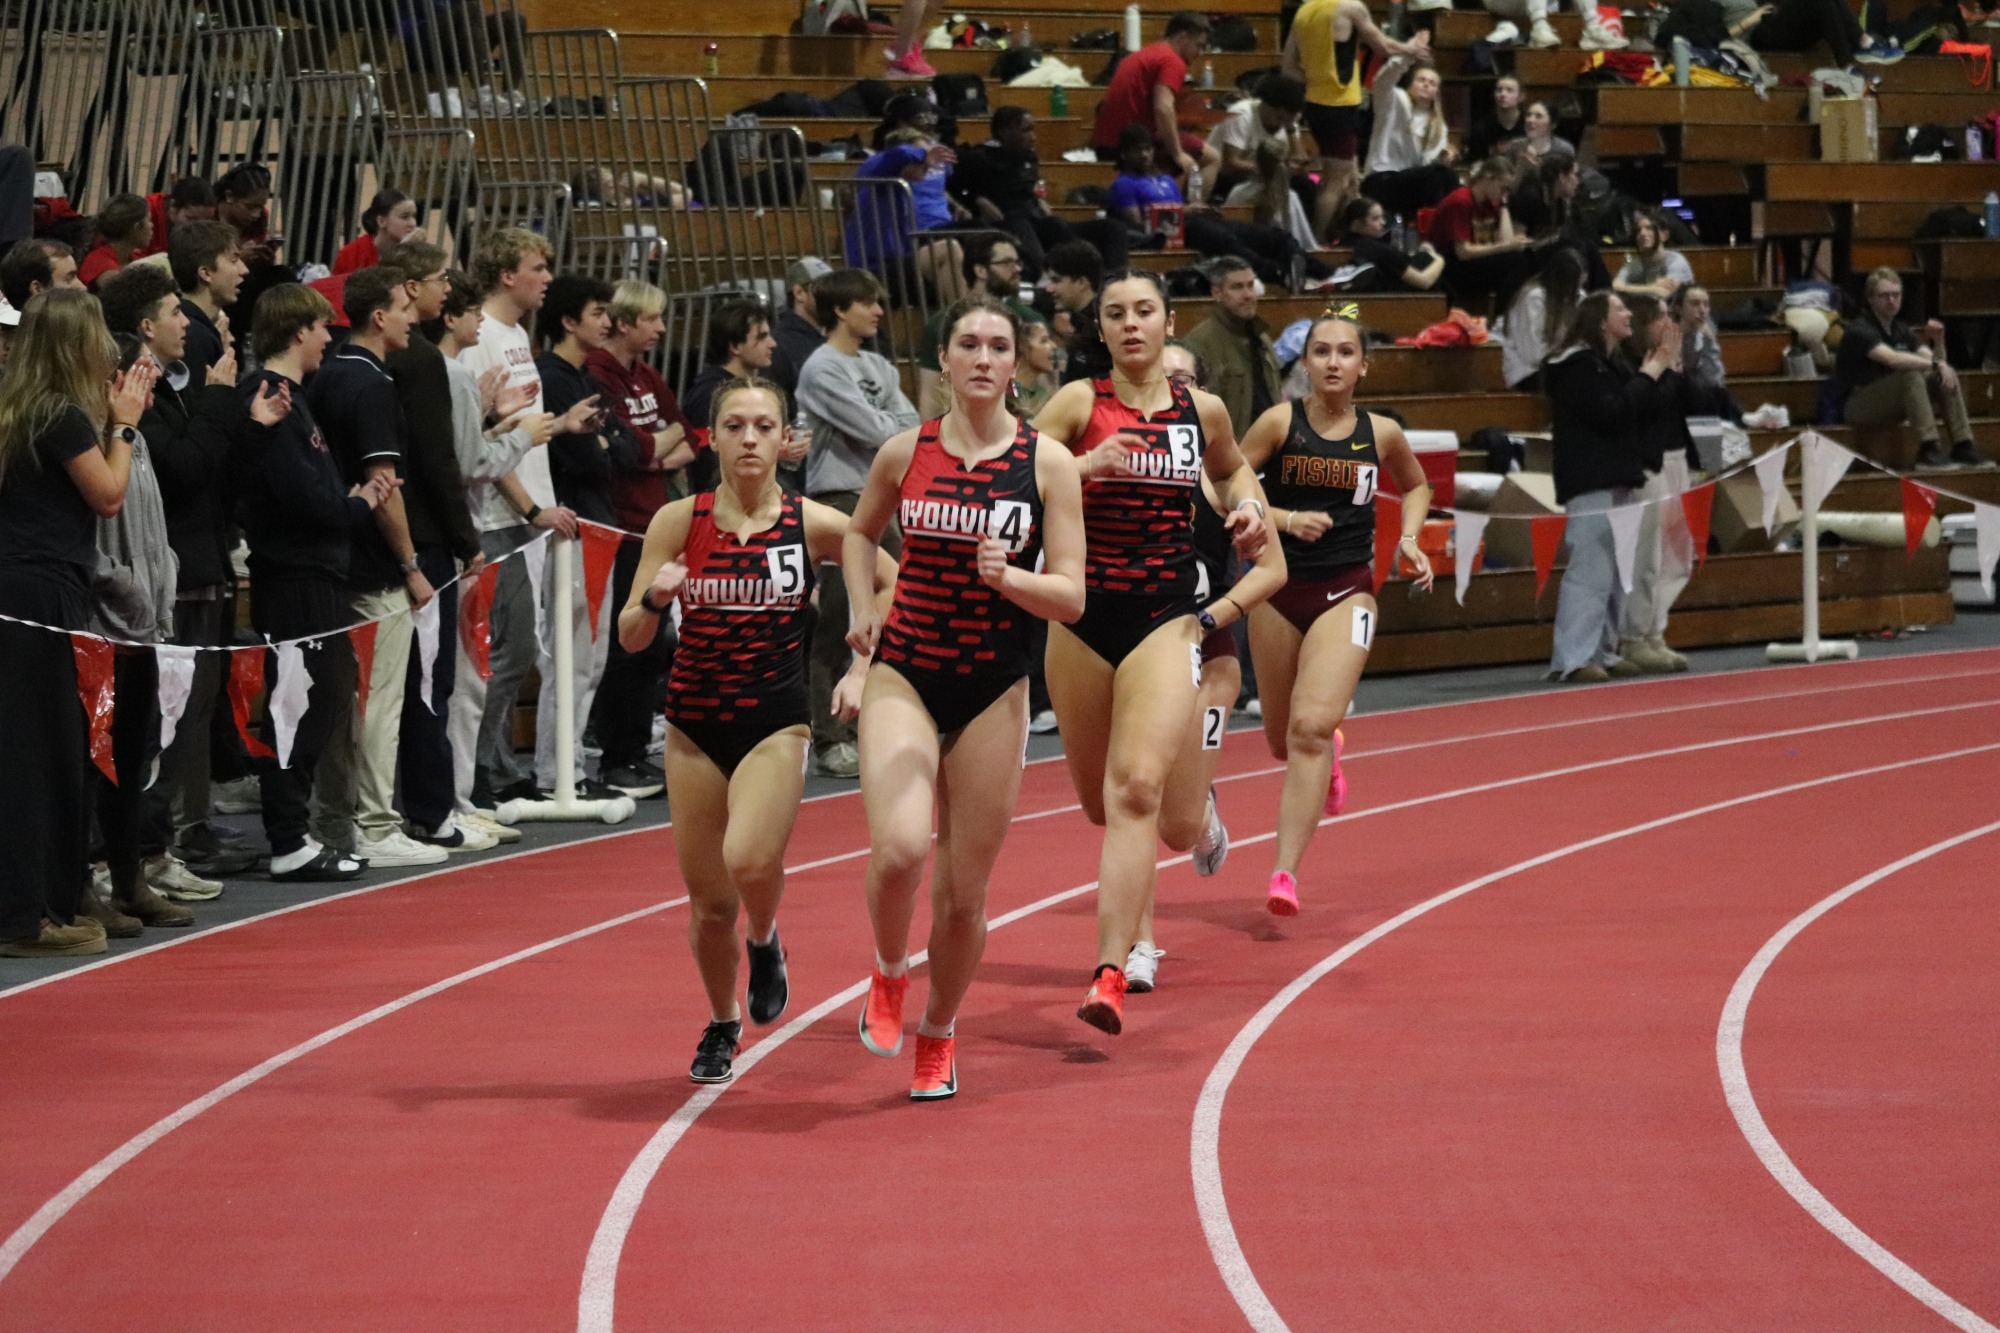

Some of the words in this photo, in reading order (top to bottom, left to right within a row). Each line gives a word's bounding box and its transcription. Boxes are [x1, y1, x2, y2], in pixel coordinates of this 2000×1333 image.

[1176, 426, 1196, 468] 3
[1281, 455, 1375, 490] FISHE
[1364, 469, 1374, 503] 1
[998, 506, 1022, 550] 4
[777, 548, 799, 594] 5
[1360, 611, 1370, 646] 1
[1205, 708, 1221, 747] 2
